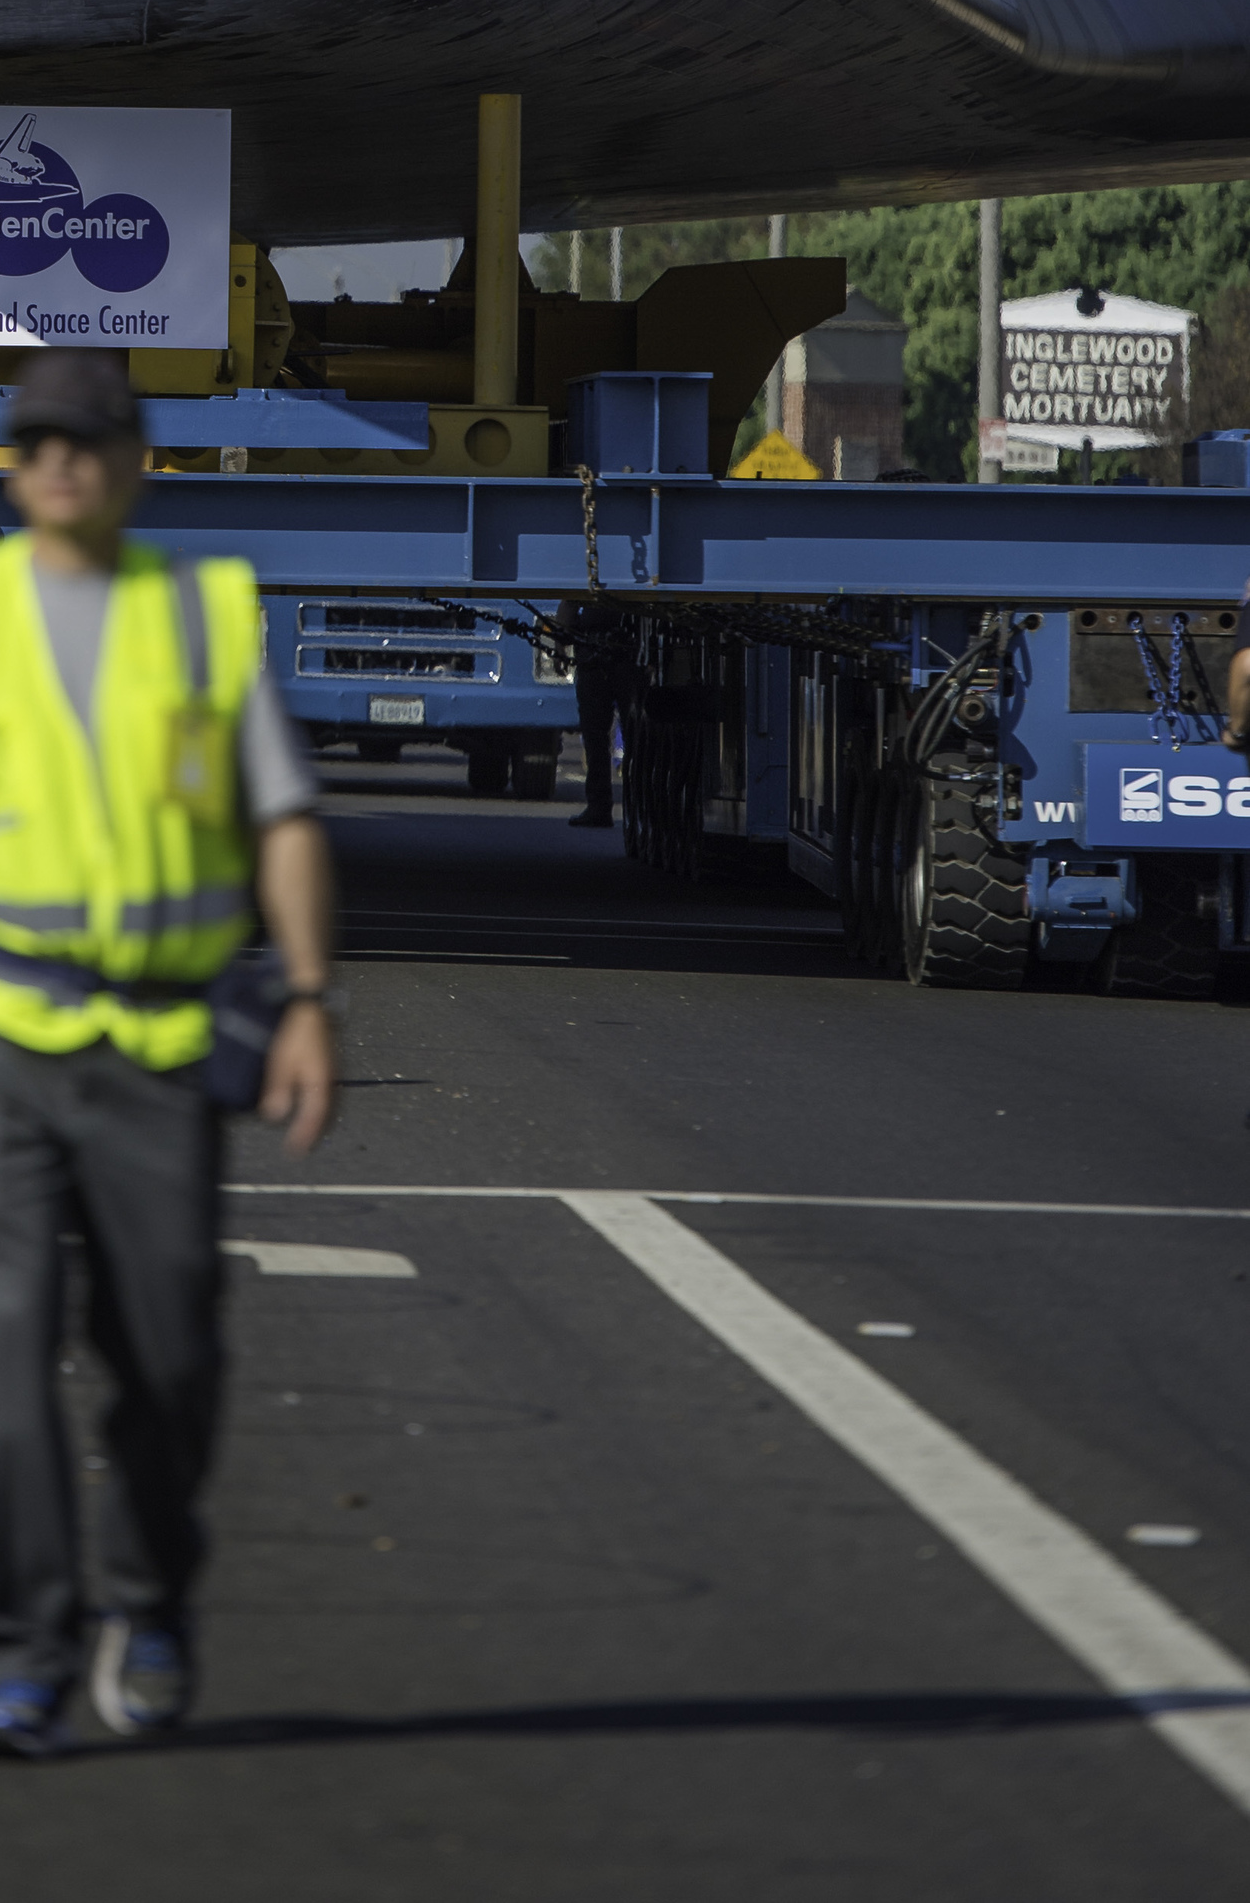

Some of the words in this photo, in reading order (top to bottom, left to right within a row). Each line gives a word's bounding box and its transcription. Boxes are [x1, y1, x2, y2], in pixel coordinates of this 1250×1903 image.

[26, 303, 90, 340] Space
[98, 305, 170, 336] Center
[1005, 332, 1174, 365] INGLEWOOD
[1010, 363, 1168, 395] CEMETERY
[1003, 393, 1172, 425] MORTUARY
